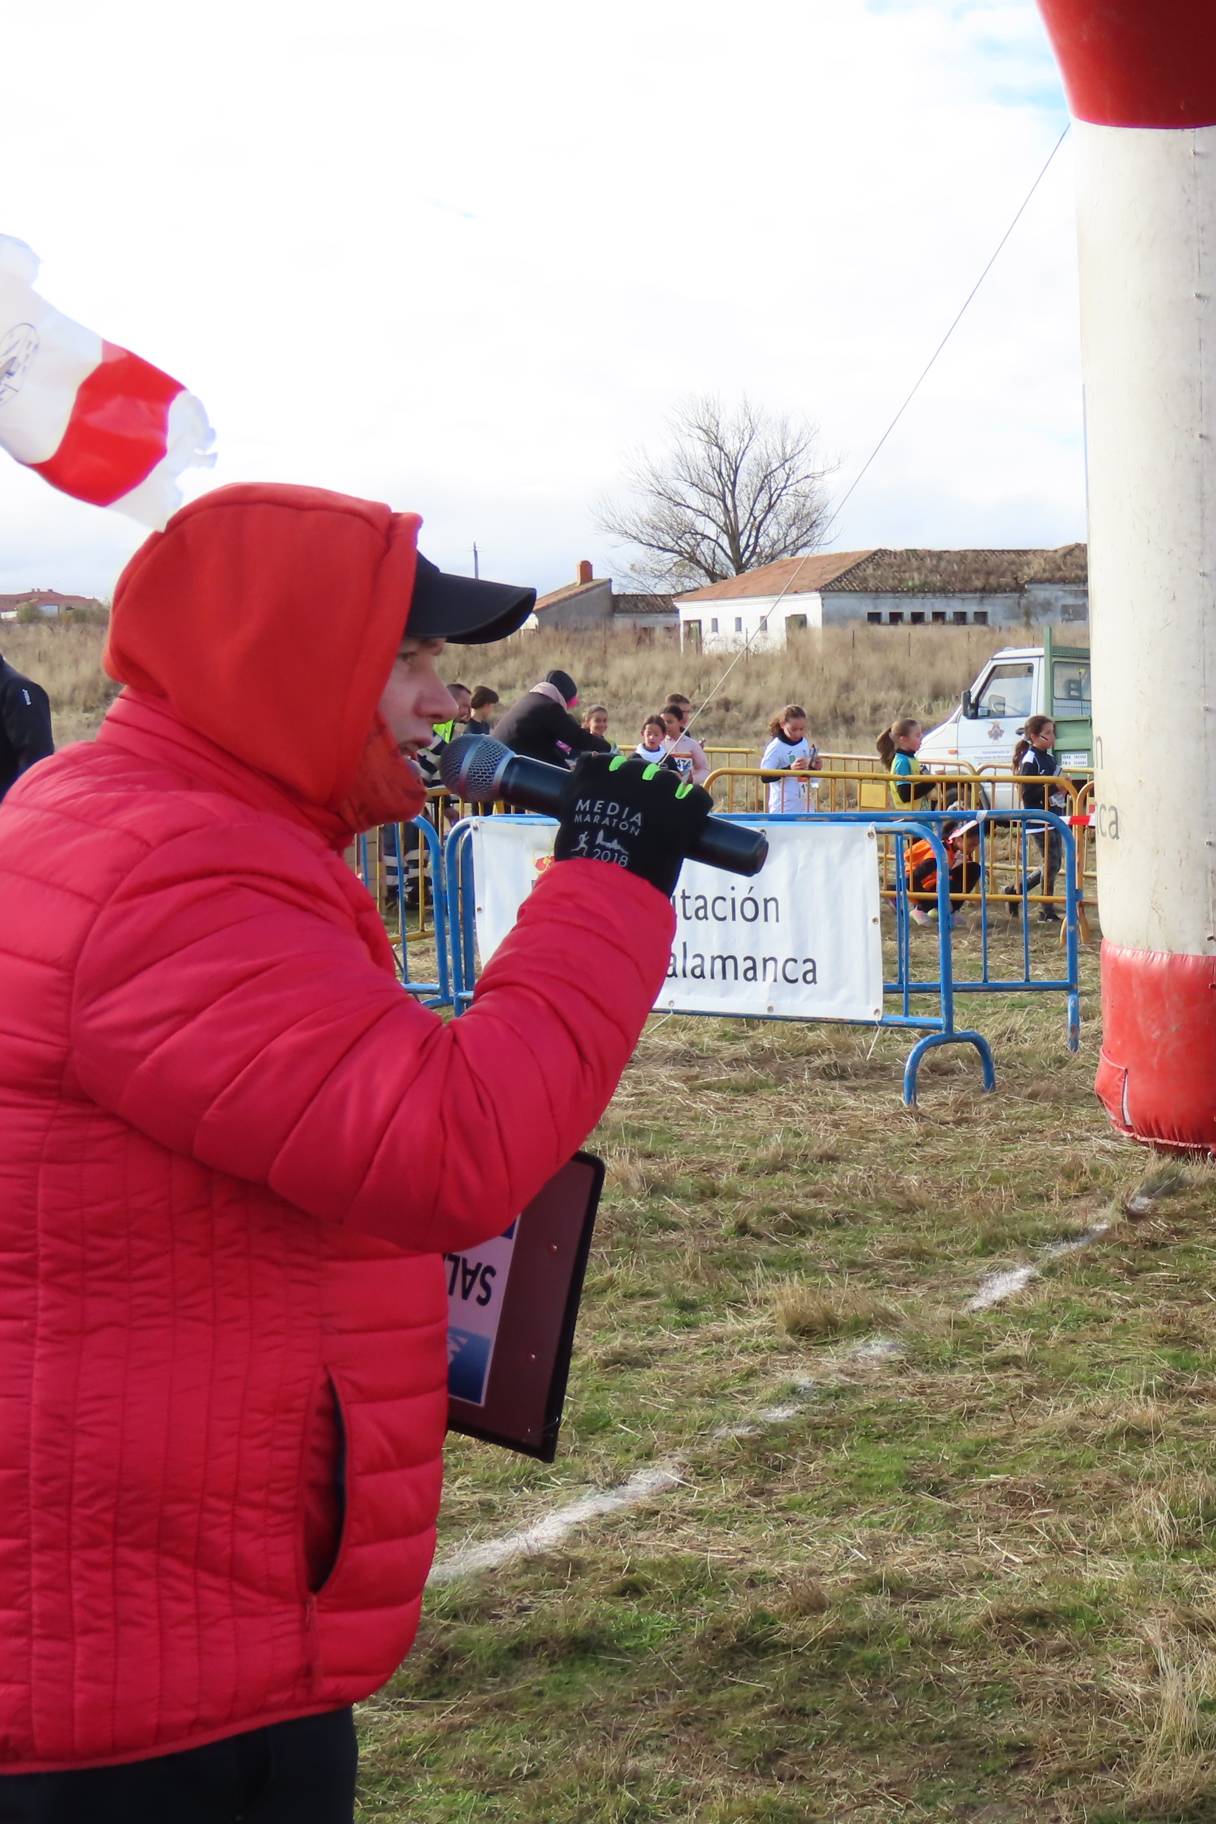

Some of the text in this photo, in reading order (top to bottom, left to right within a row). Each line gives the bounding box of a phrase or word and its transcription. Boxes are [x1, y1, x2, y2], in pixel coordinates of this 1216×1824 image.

[575, 799, 642, 826] MEDIA
[592, 848, 629, 868] 2018
[672, 886, 780, 923] tación
[666, 941, 818, 985] alamanca
